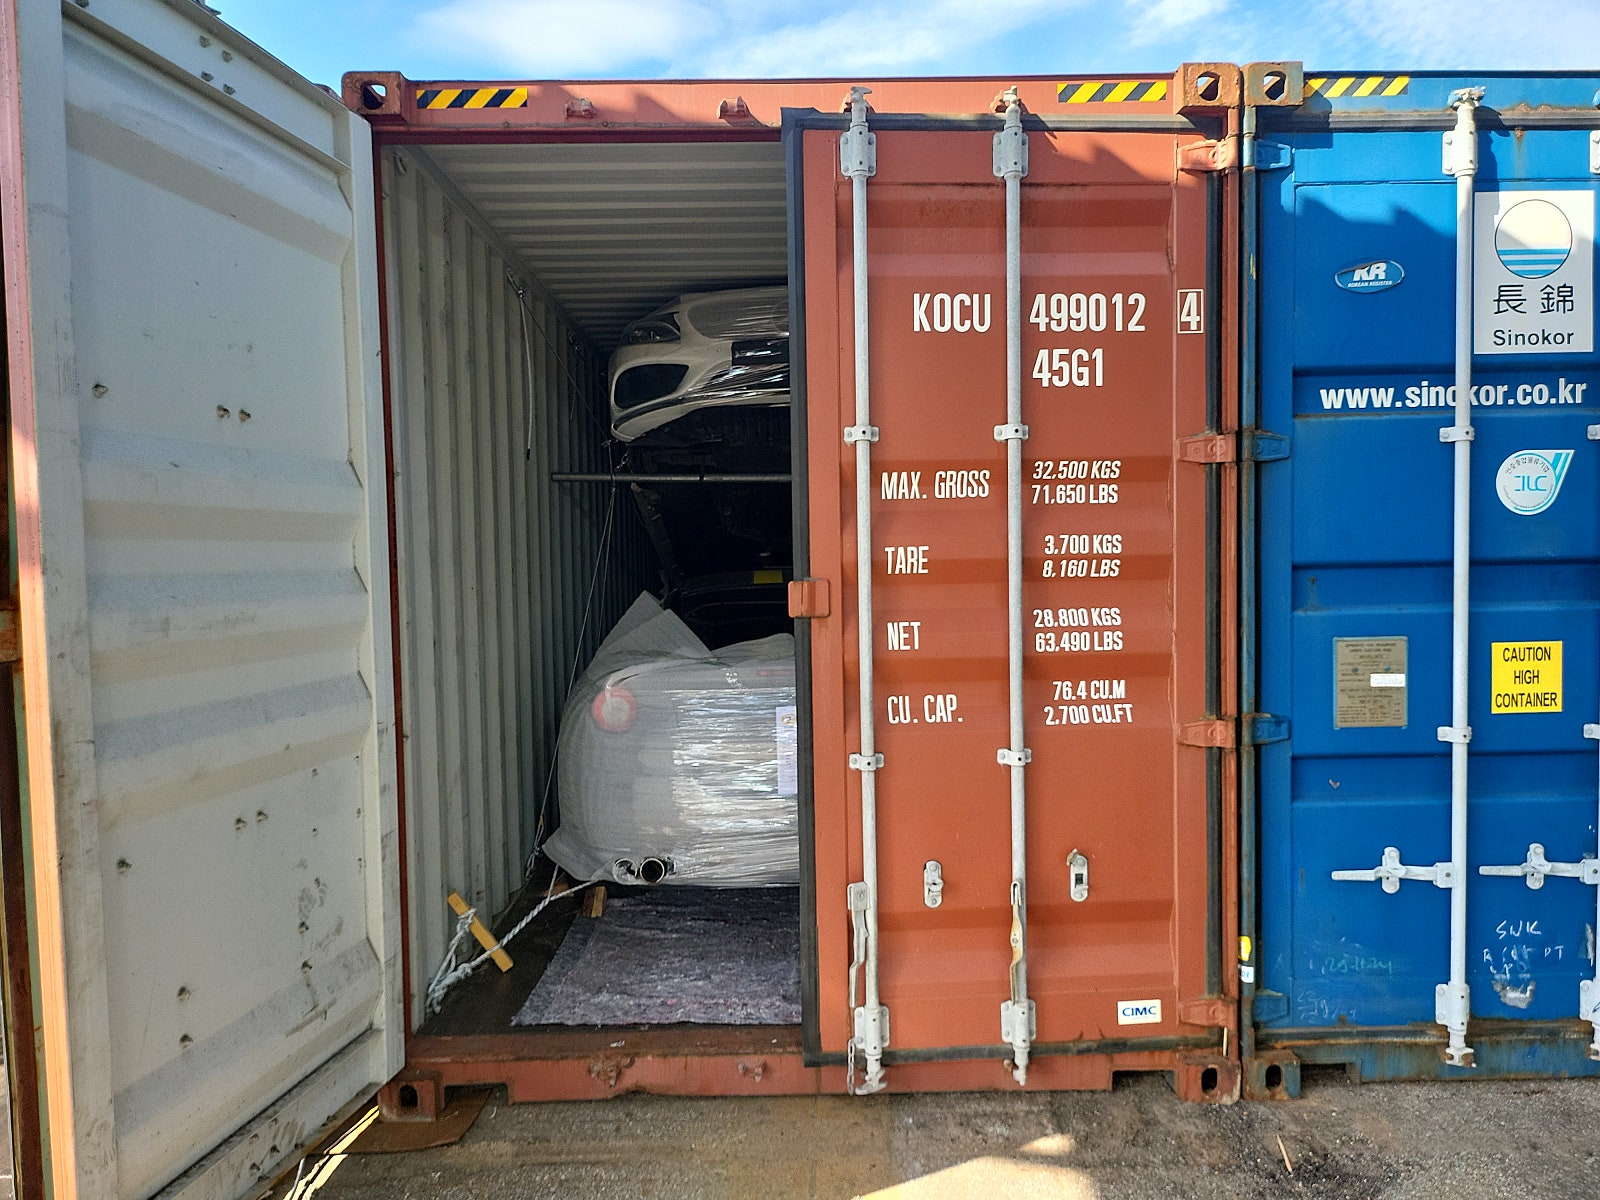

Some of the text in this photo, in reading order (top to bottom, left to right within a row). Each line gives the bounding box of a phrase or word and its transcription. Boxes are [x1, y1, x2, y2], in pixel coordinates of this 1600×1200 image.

[1353, 262, 1387, 281] KR
[913, 291, 1201, 333] KOCU 499012 4
[1493, 328, 1575, 346] Sinokor
[1032, 348, 1104, 388] 45G1
[1090, 460, 1121, 479] KGS
[881, 469, 990, 500] MAX. GROSS
[1089, 483, 1119, 504] LBS
[1092, 534, 1123, 554] KGS
[884, 545, 930, 575] TARE
[1090, 559, 1121, 577] LBS
[1090, 607, 1122, 627] KGS
[887, 621, 921, 651] NET
[1093, 630, 1123, 651] LBS
[1502, 646, 1551, 662] CAUTION
[1513, 669, 1540, 685] HIGH
[1052, 680, 1088, 701] 76.4
[1495, 692, 1558, 708] CONTAINER
[887, 693, 963, 725] CU. CAP.
[1122, 1005, 1157, 1017] CIMC
